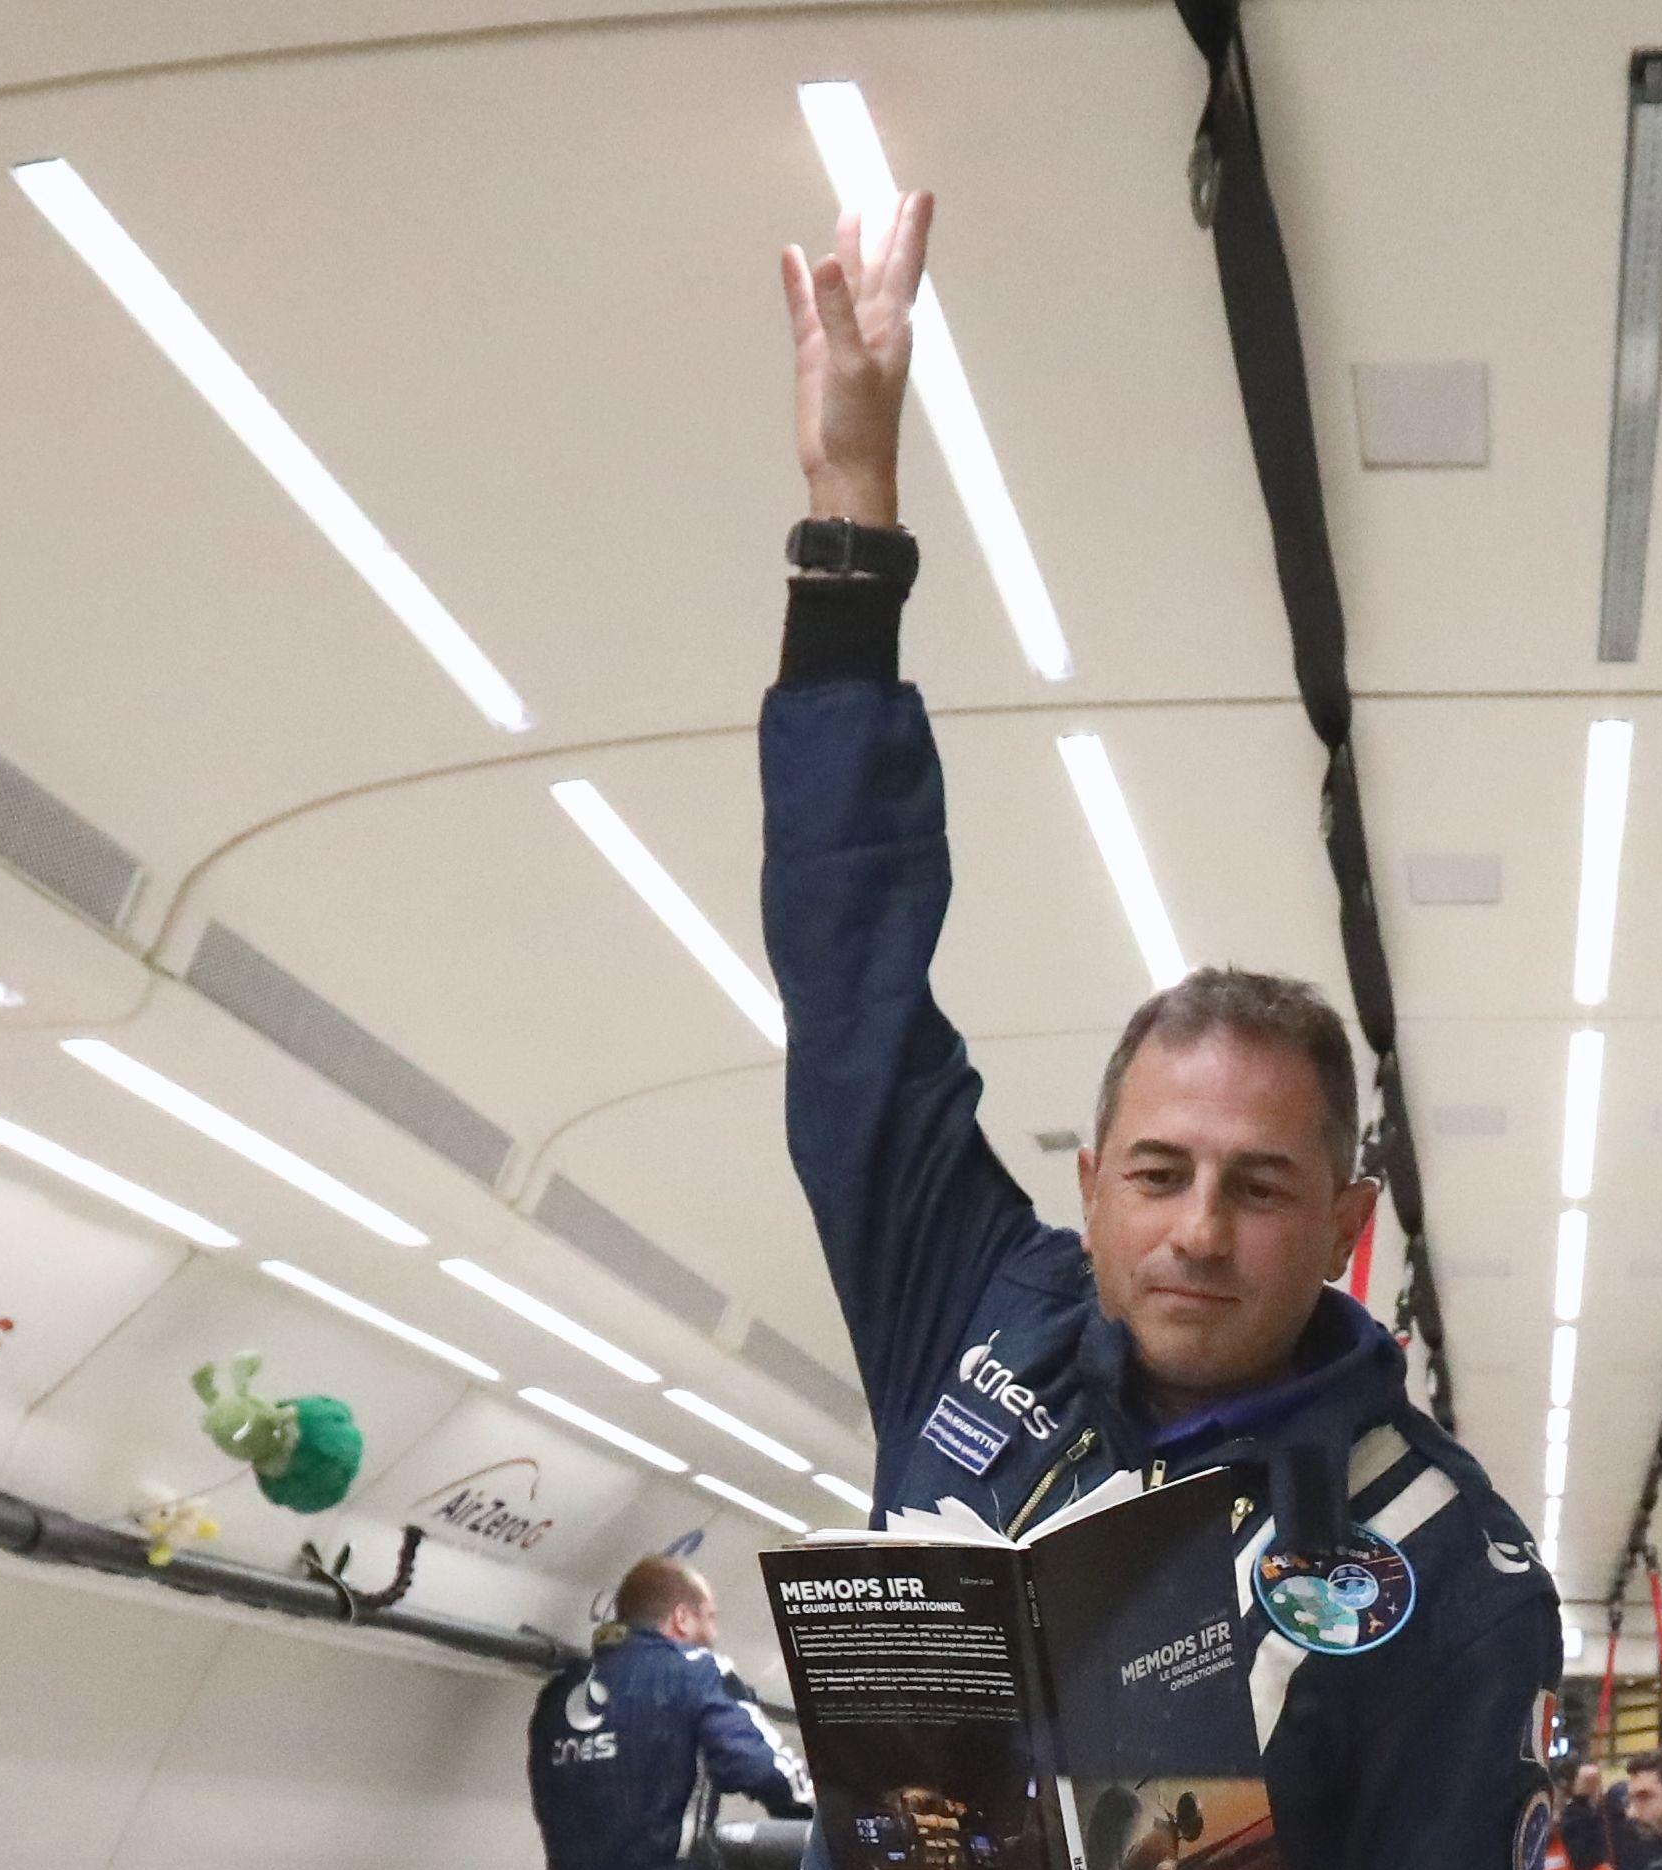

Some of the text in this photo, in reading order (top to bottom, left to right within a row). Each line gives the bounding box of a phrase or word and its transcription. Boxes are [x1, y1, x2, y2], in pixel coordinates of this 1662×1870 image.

[973, 1359, 1059, 1440] cnes
[779, 1577, 926, 1601] MEMOPS IFR
[785, 1599, 965, 1615] LE GUIDE DE L'IFR OPÉRATIONNEL
[1121, 1621, 1231, 1686] MEMOPS IFR
[1159, 1669, 1171, 1681] LE
[1171, 1657, 1198, 1677] GUIDE
[1198, 1651, 1211, 1664] DE
[1170, 1657, 1236, 1691] OPÉRATIONNEL
